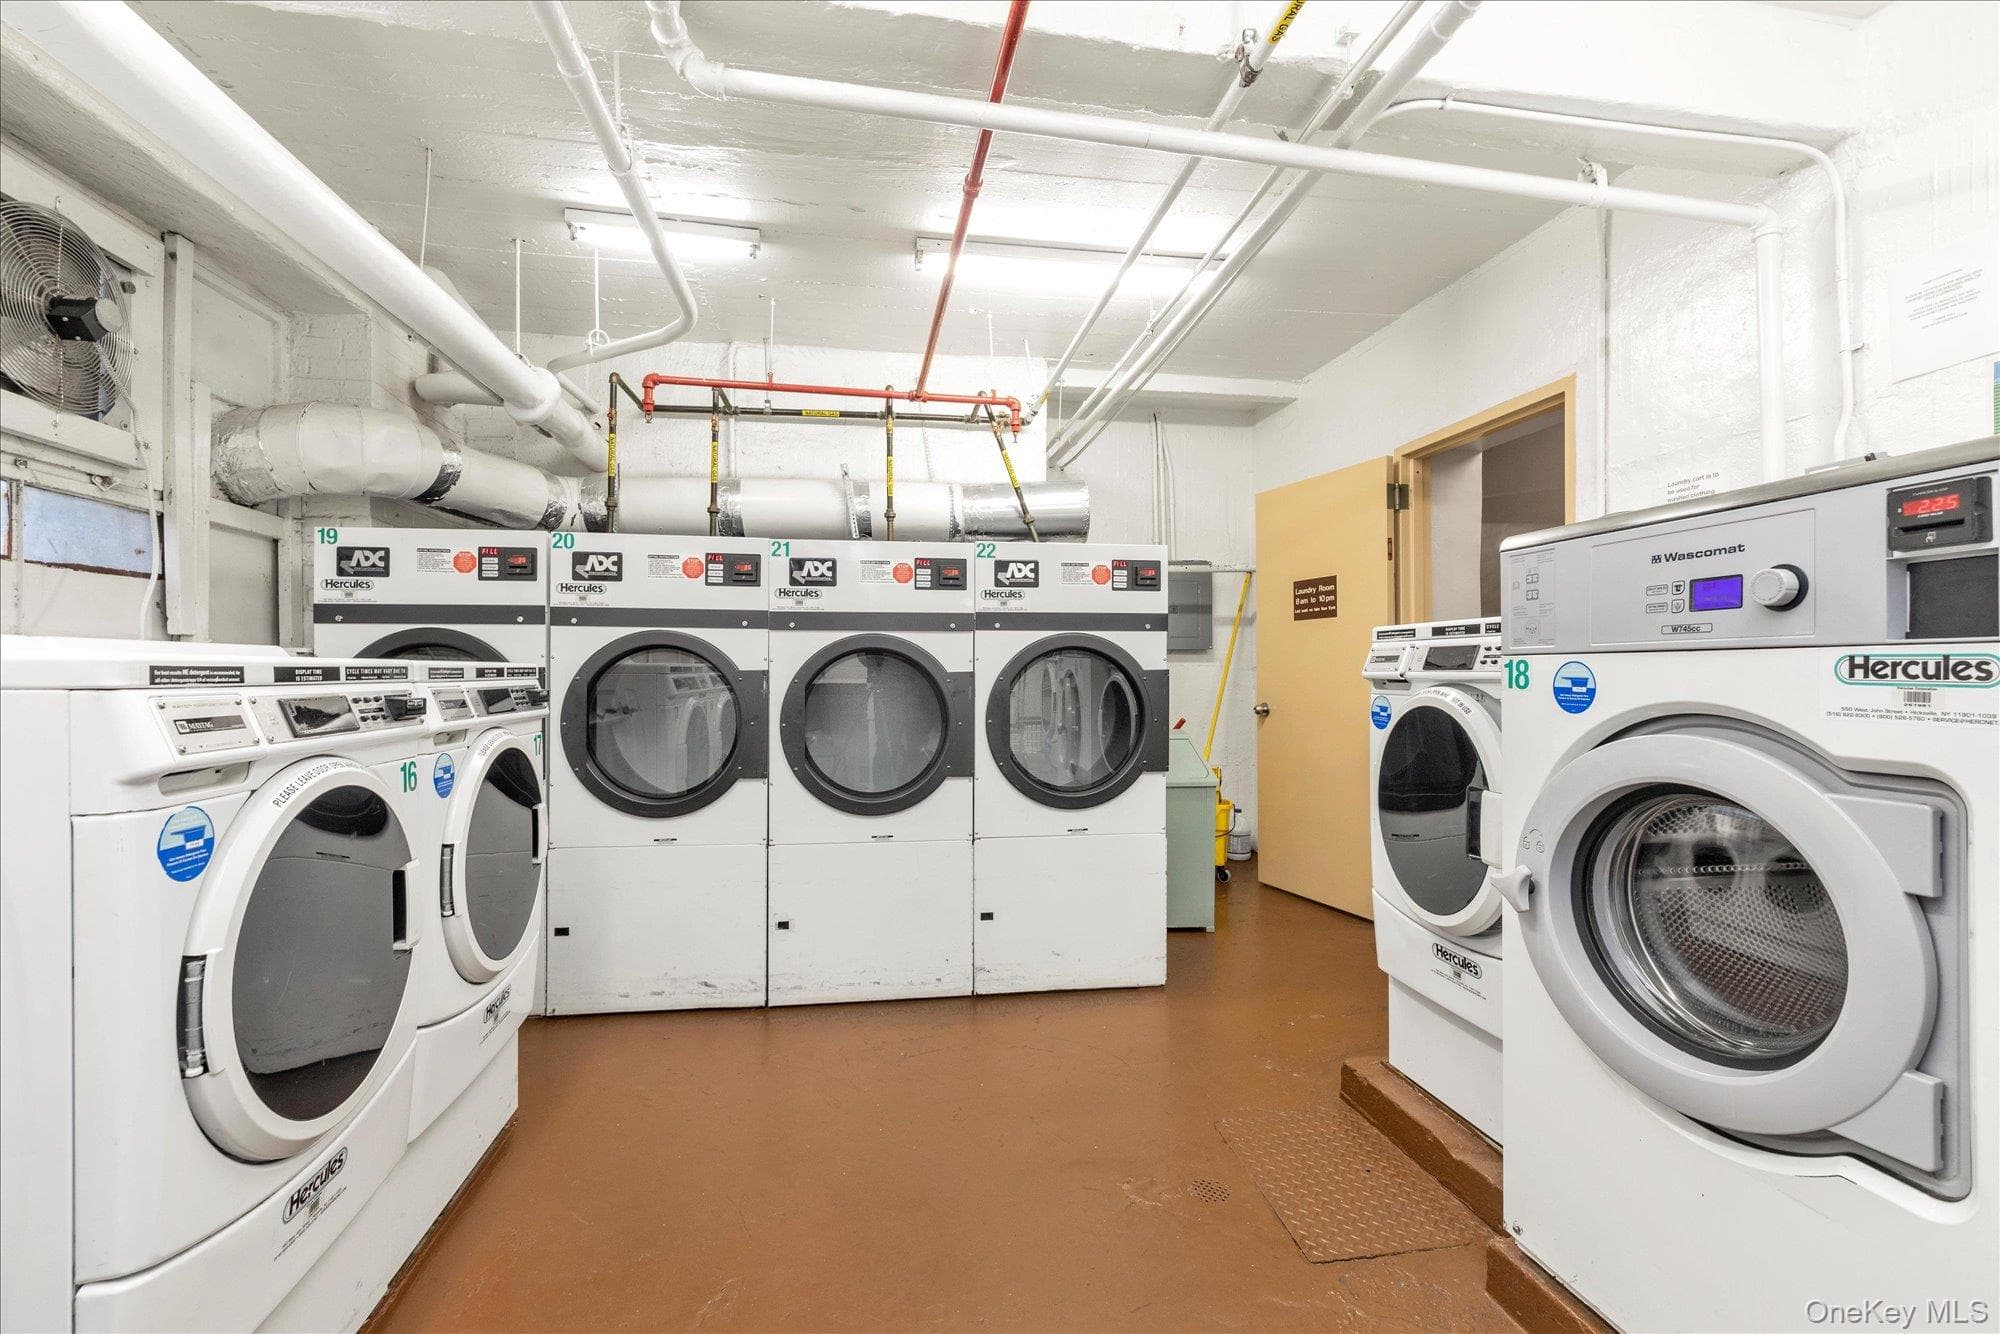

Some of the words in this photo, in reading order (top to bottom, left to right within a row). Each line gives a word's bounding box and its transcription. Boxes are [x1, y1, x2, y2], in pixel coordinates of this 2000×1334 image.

[1271, 23, 1289, 42] GAS
[1667, 478, 1691, 488] Laundry
[1692, 474, 1705, 482] cart
[1676, 485, 1691, 493] used
[317, 527, 338, 545] 19
[552, 533, 575, 549] 20
[771, 541, 790, 557] 21
[976, 543, 996, 559] 22
[1664, 542, 1746, 563] Wascomat
[349, 549, 385, 567] ADC
[585, 554, 618, 571] ADC
[801, 561, 833, 577] ADC
[1006, 562, 1035, 578] ADC
[325, 579, 371, 589] Hercules
[560, 583, 604, 593] Hercules
[1295, 587, 1317, 595] Laundry
[778, 588, 819, 597] Hercules
[984, 590, 1023, 599] Hercules
[1671, 625, 1702, 633] W745cc
[1504, 659, 1530, 690] 18
[1848, 654, 1994, 682] Hercules
[1462, 703, 1473, 715] USE
[1884, 707, 1903, 715] Street
[188, 721, 214, 730] MAYTAG
[533, 734, 542, 756] 17
[272, 783, 300, 808] PLEASE
[296, 768, 317, 787] LEAVE
[312, 763, 330, 776] DOOR
[328, 761, 345, 769] OPEN
[400, 760, 418, 793] 16
[1435, 943, 1479, 976] Hercules
[486, 987, 511, 1020] Hercules
[289, 1152, 344, 1217] Hercules
